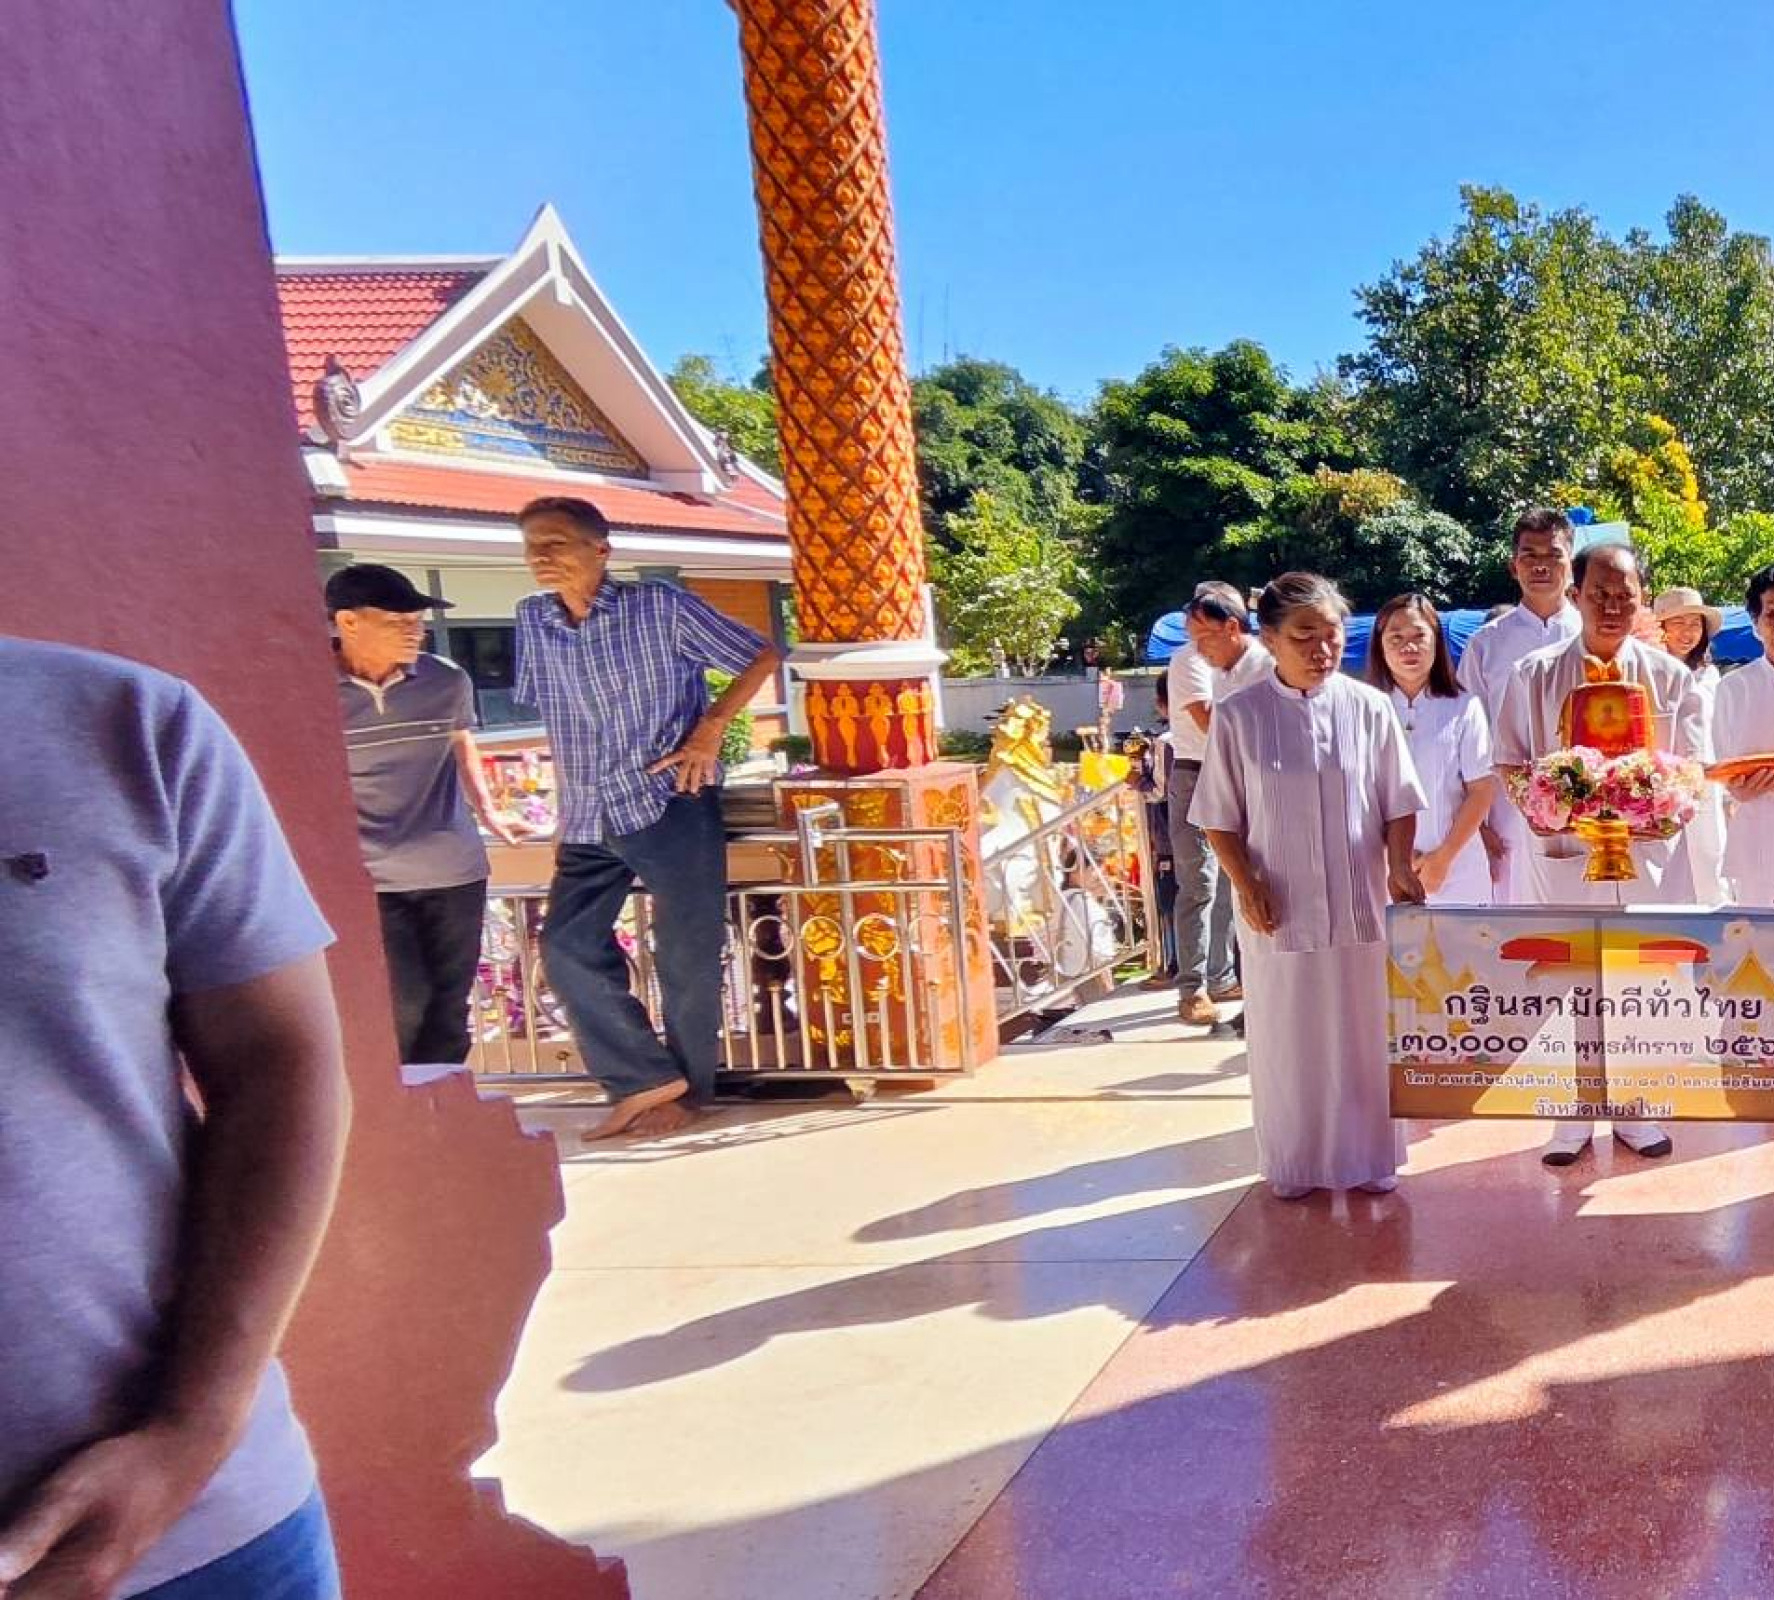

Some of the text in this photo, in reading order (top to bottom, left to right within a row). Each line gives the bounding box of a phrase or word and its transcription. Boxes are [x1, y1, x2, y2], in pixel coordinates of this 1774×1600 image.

[1445, 979, 1762, 1025] กฐินสามัคคีทั่วไทย
[1538, 1033, 1565, 1053] วัด
[1573, 1034, 1694, 1060] พุทธศักราช
[1534, 1096, 1673, 1117] จังหวัดเชียงใหม่
